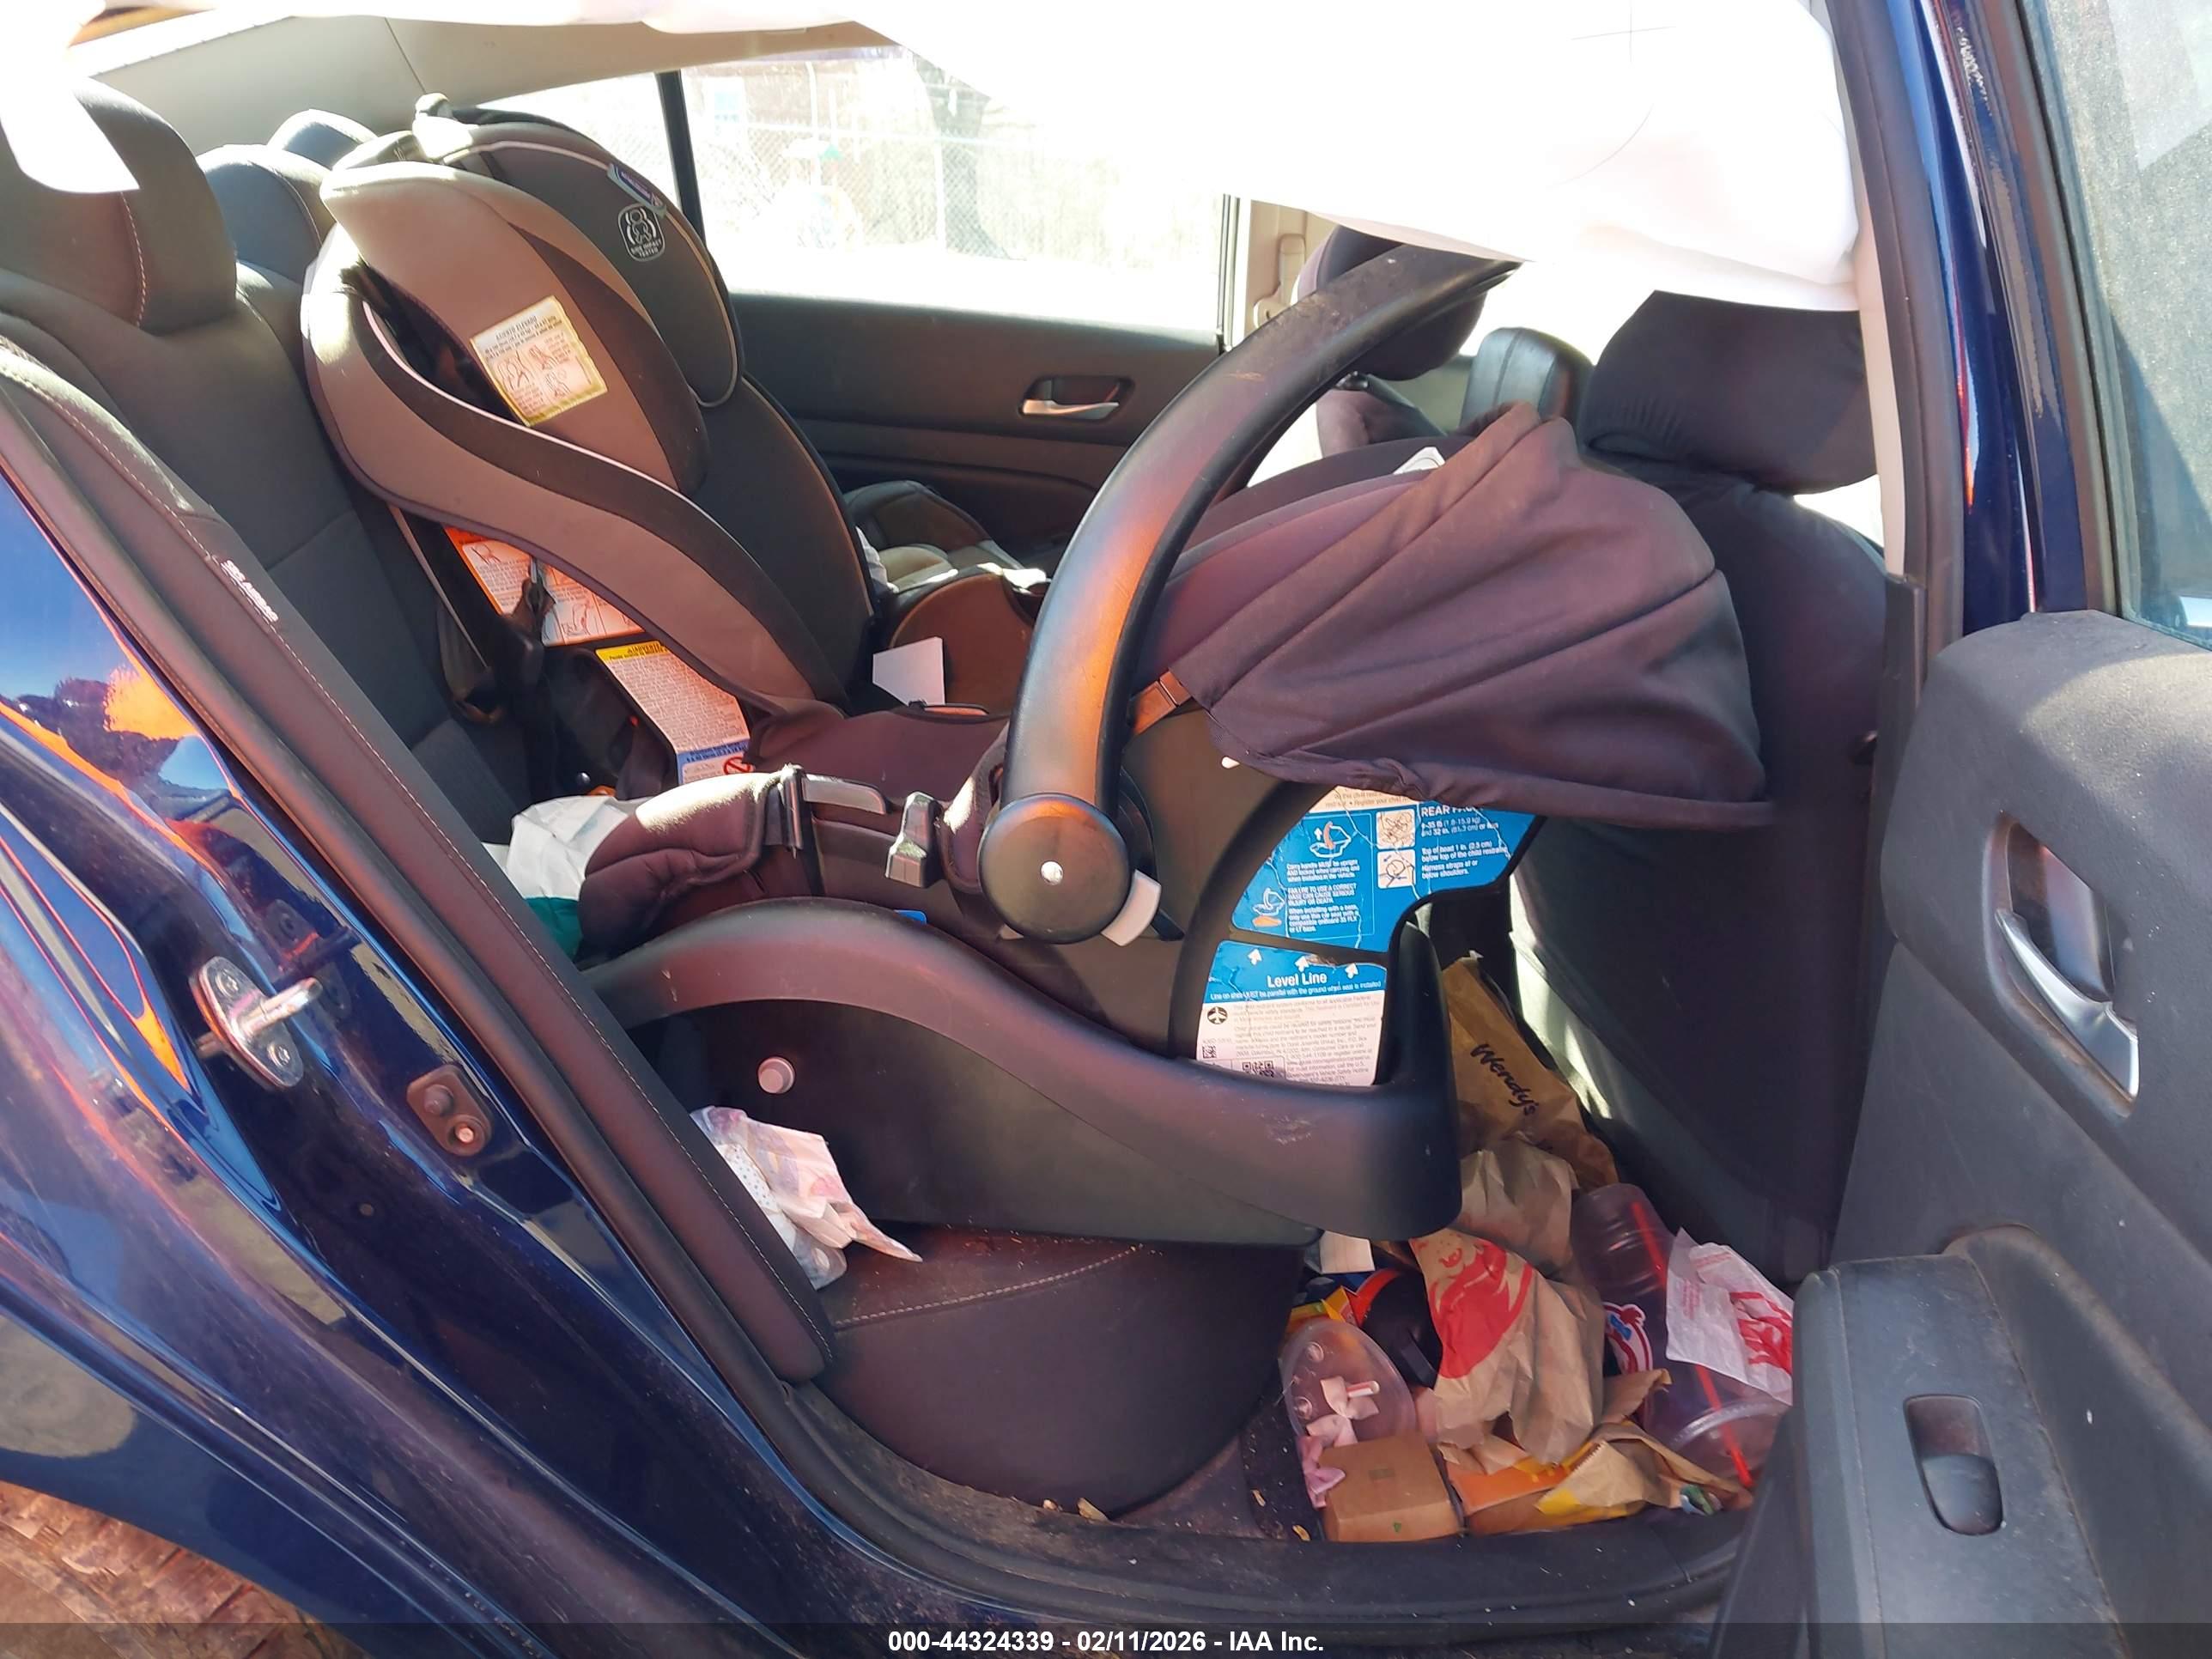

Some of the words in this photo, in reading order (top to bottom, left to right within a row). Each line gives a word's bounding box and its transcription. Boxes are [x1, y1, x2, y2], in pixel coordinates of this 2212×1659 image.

[1421, 804, 1450, 817] REAR
[1422, 864, 1444, 872] Harness
[1446, 862, 1463, 871] straps
[1422, 871, 1439, 879] below
[1440, 869, 1469, 878] shoulders.
[1333, 883, 1357, 891] CORRECT
[1267, 975, 1299, 988] Level
[1302, 973, 1328, 986] Line
[1309, 986, 1327, 995] ground
[1470, 1043, 1539, 1116] Wendy's
